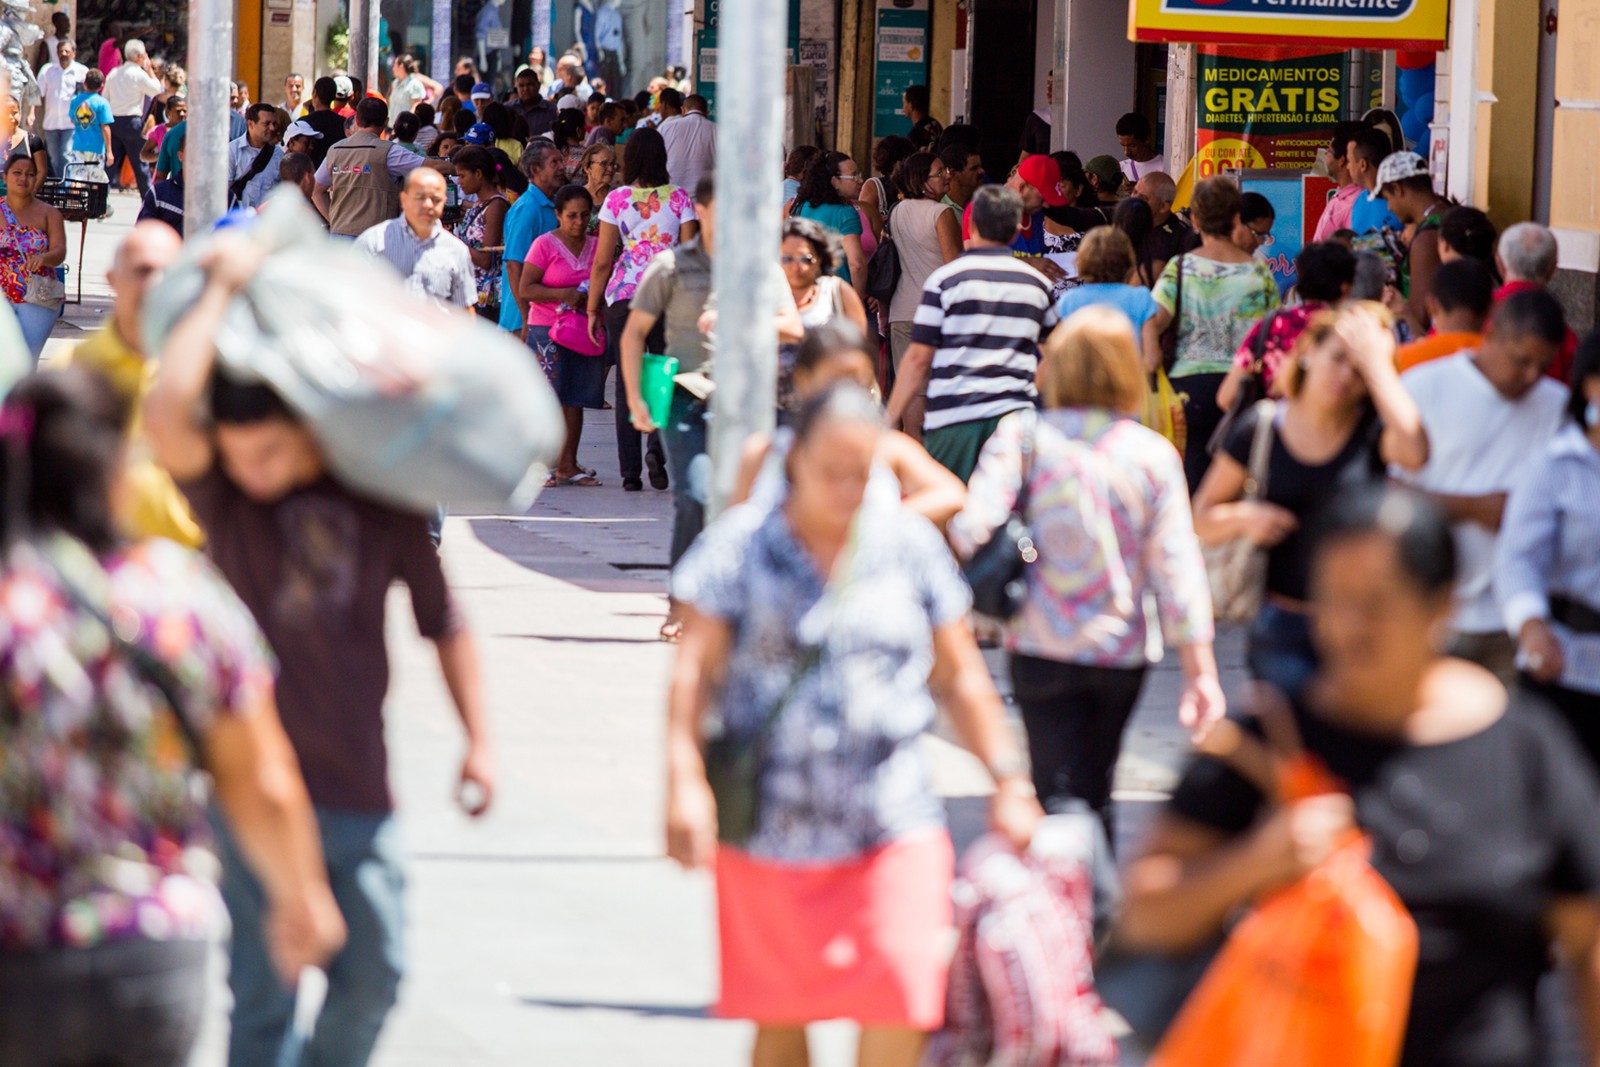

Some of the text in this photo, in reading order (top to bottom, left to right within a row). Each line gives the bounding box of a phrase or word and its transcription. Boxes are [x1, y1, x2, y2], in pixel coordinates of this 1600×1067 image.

[1204, 68, 1340, 82] MEDICAMENTOS
[1204, 82, 1340, 112] GRÁTIS
[1205, 111, 1338, 124] DIABETES, HIPERTENSÃO E ASMA.
[1205, 145, 1252, 158] OU COM ATÉ
[1306, 150, 1317, 158] GL
[1275, 161, 1313, 169] OSTEOPOR
